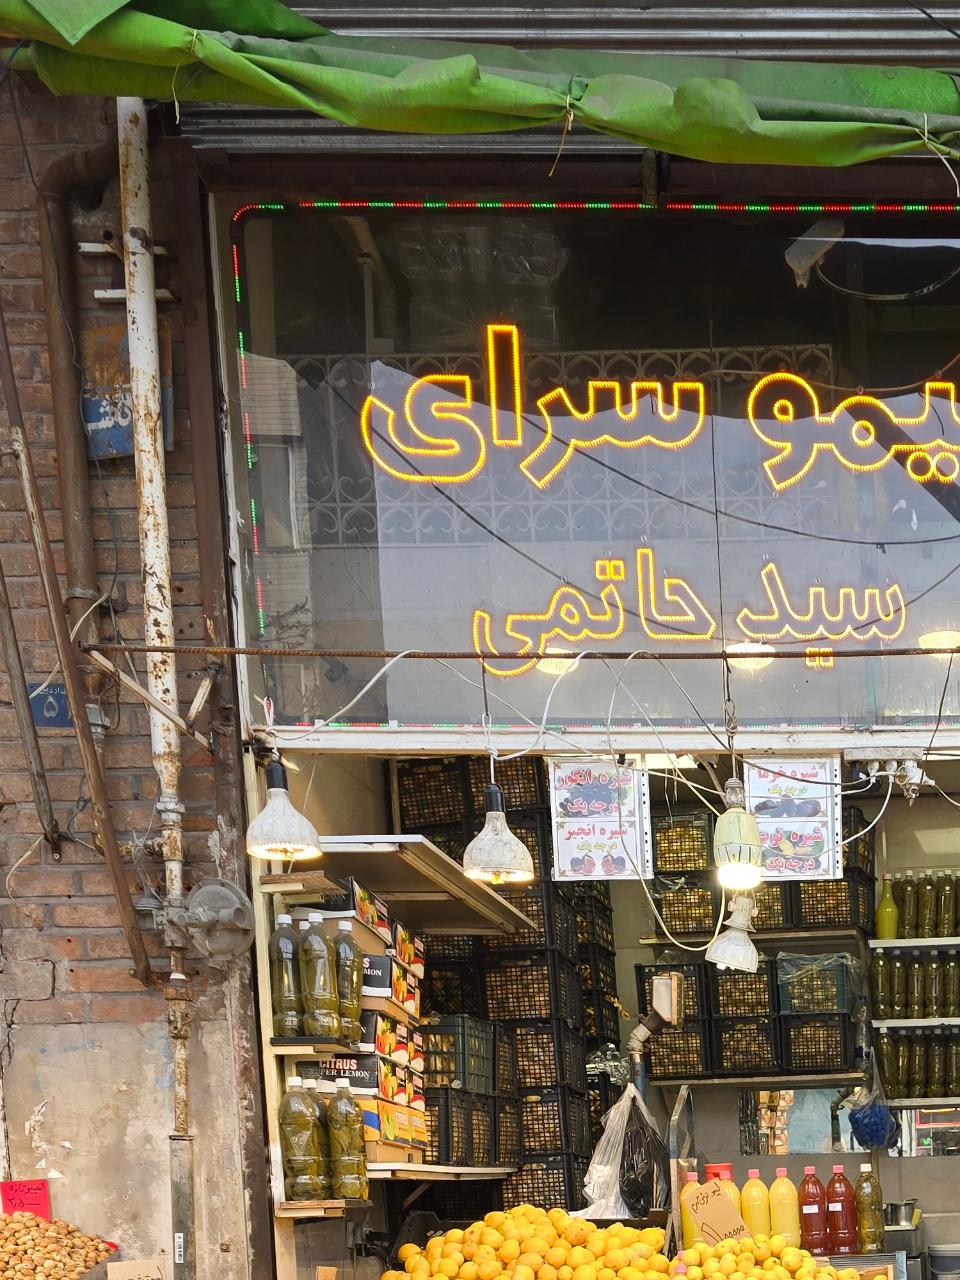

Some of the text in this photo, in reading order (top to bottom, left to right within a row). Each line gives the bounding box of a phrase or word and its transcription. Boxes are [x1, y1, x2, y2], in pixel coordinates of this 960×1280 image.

[361, 323, 705, 489] سرای
[473, 548, 906, 677] سید حاتمی
[556, 768, 592, 789] انگور
[567, 798, 588, 815] یک
[564, 823, 596, 841] انجیر
[766, 857, 816, 874] درجه یک
[320, 1058, 358, 1070] CITRUS
[341, 1070, 370, 1079] LEMON
